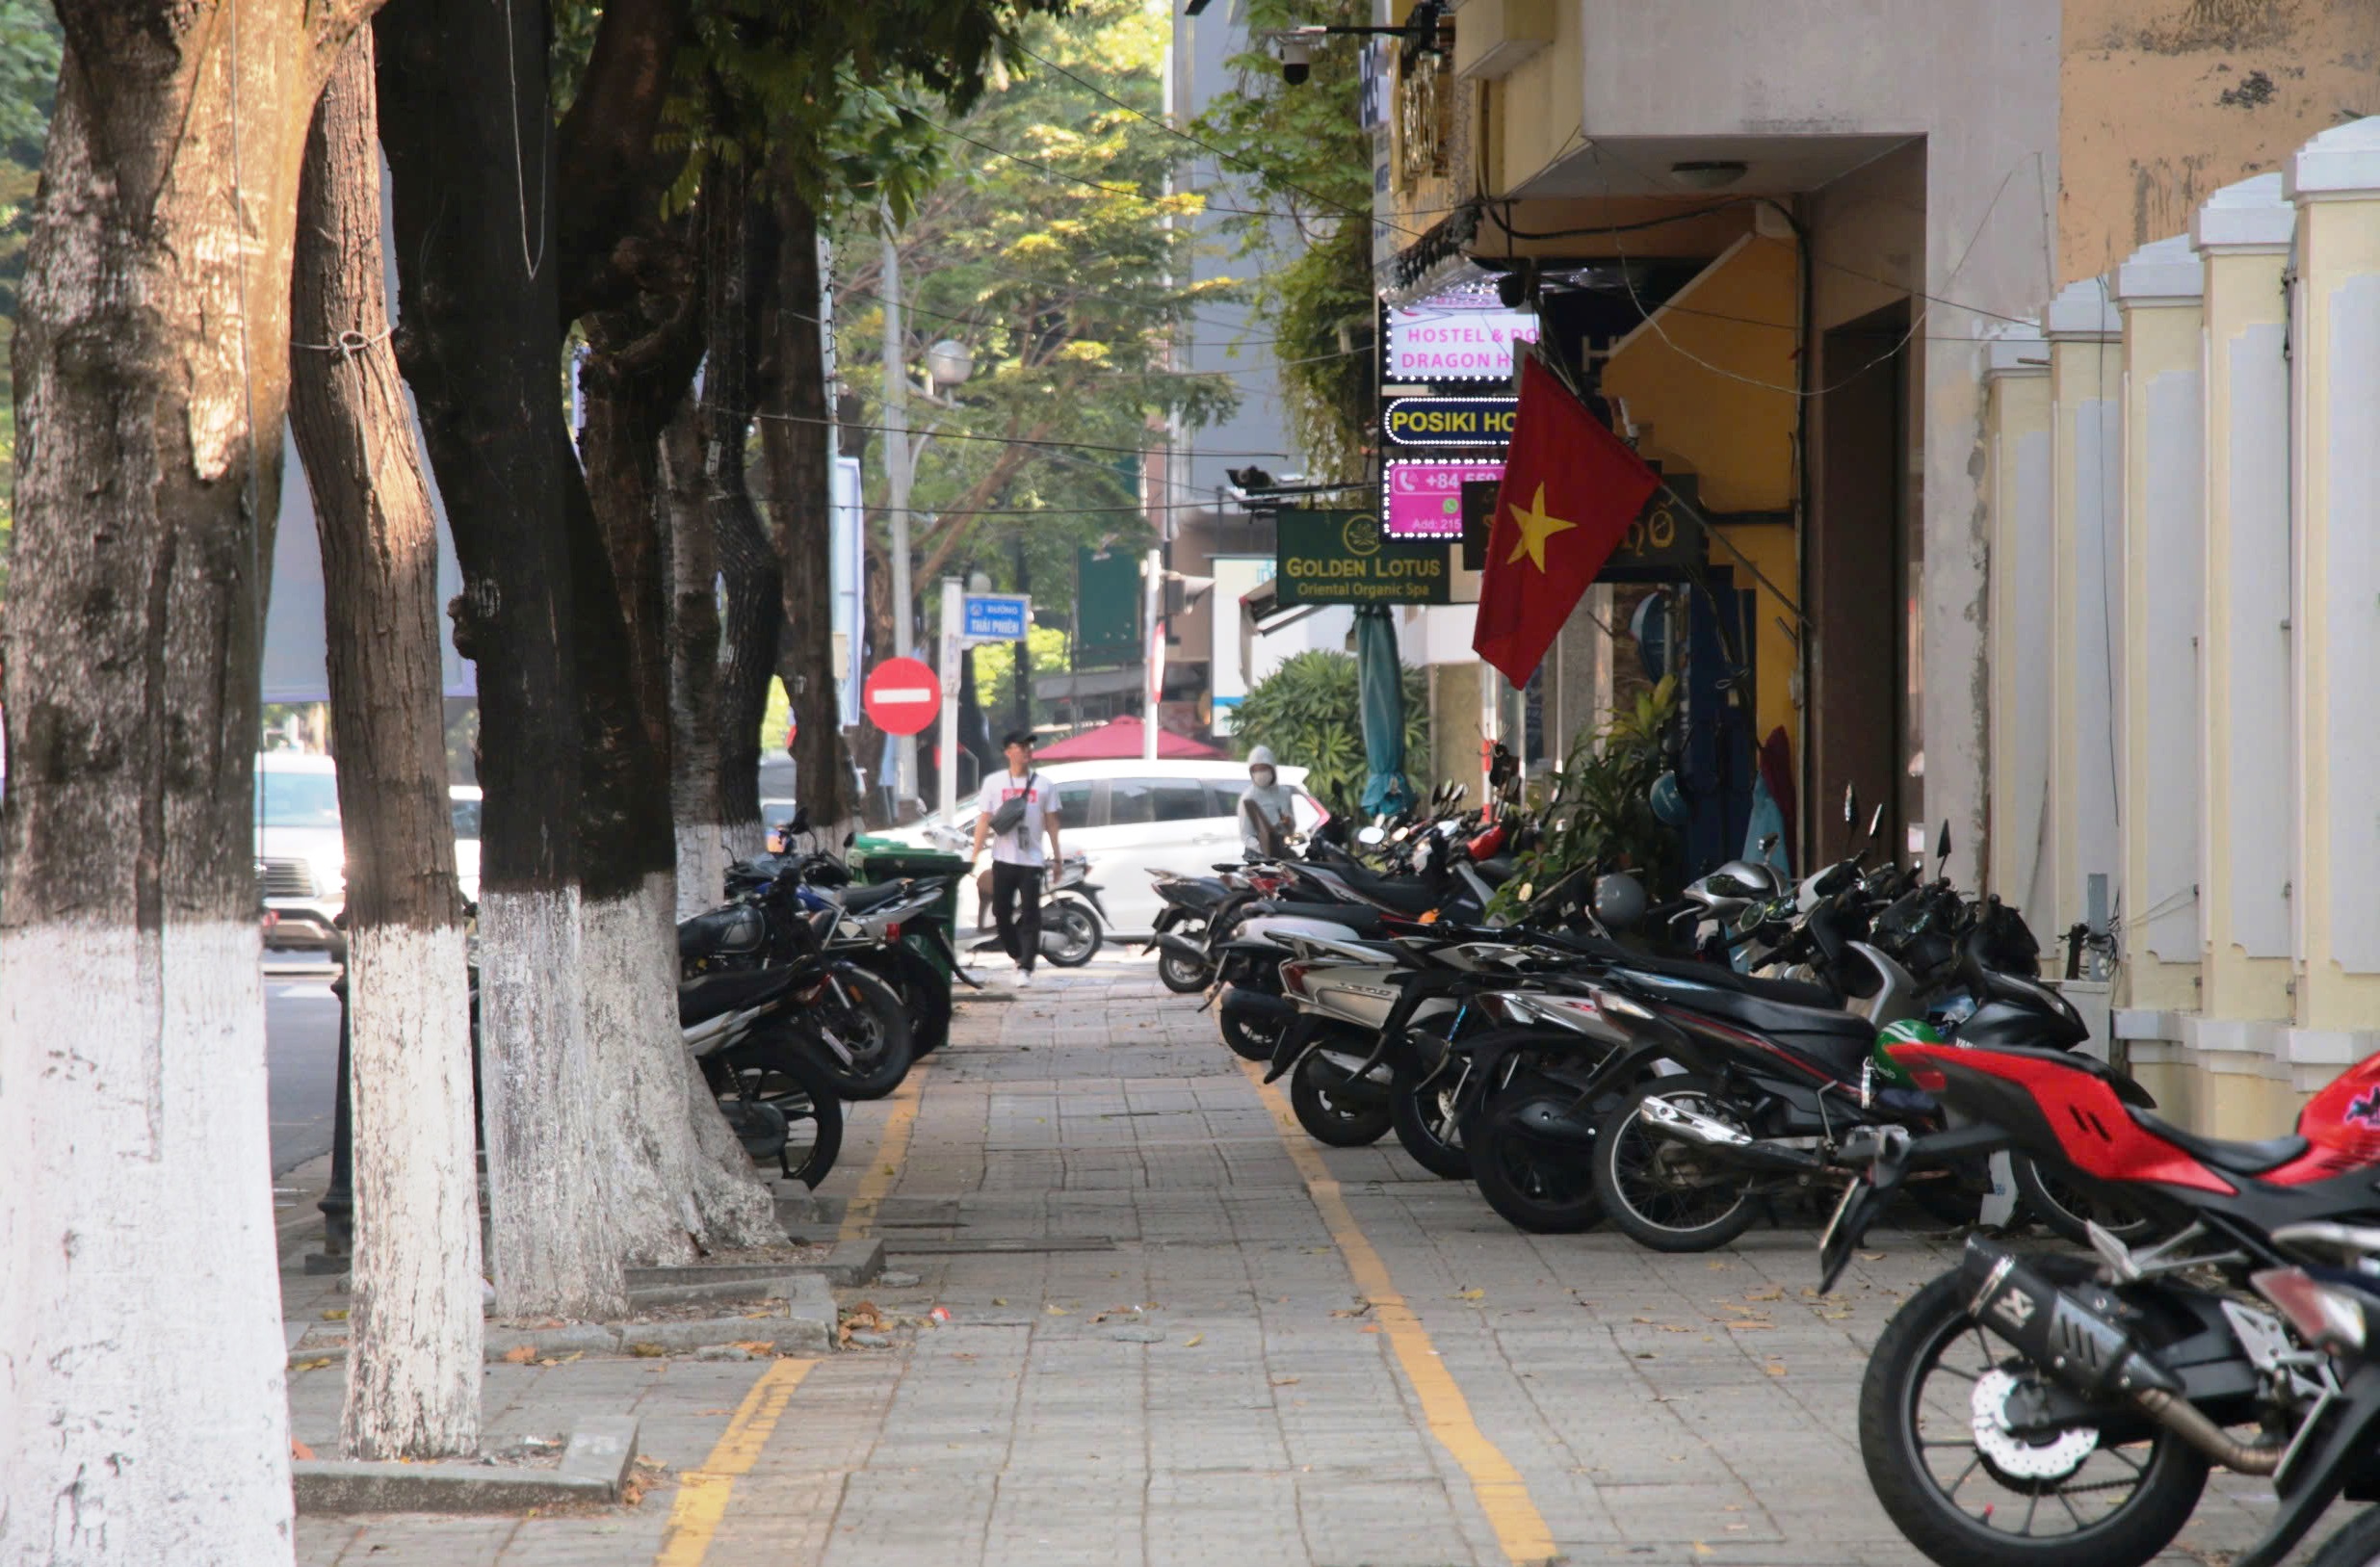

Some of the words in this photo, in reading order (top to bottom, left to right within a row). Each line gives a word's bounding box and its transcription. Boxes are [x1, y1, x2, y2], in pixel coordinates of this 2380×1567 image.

[1407, 328, 1485, 343] HOSTEL
[1491, 328, 1504, 343] &
[1401, 353, 1490, 369] DRAGON
[1392, 412, 1476, 431] POSIKI
[1426, 473, 1459, 488] +84
[1412, 519, 1437, 530] Add:
[1440, 518, 1461, 529] 215
[1286, 558, 1367, 577] GOLDEN
[1375, 558, 1440, 577] LOTUS
[1297, 583, 1348, 596] Oriental
[1352, 583, 1401, 599] Organic
[1406, 583, 1429, 597] Spa
